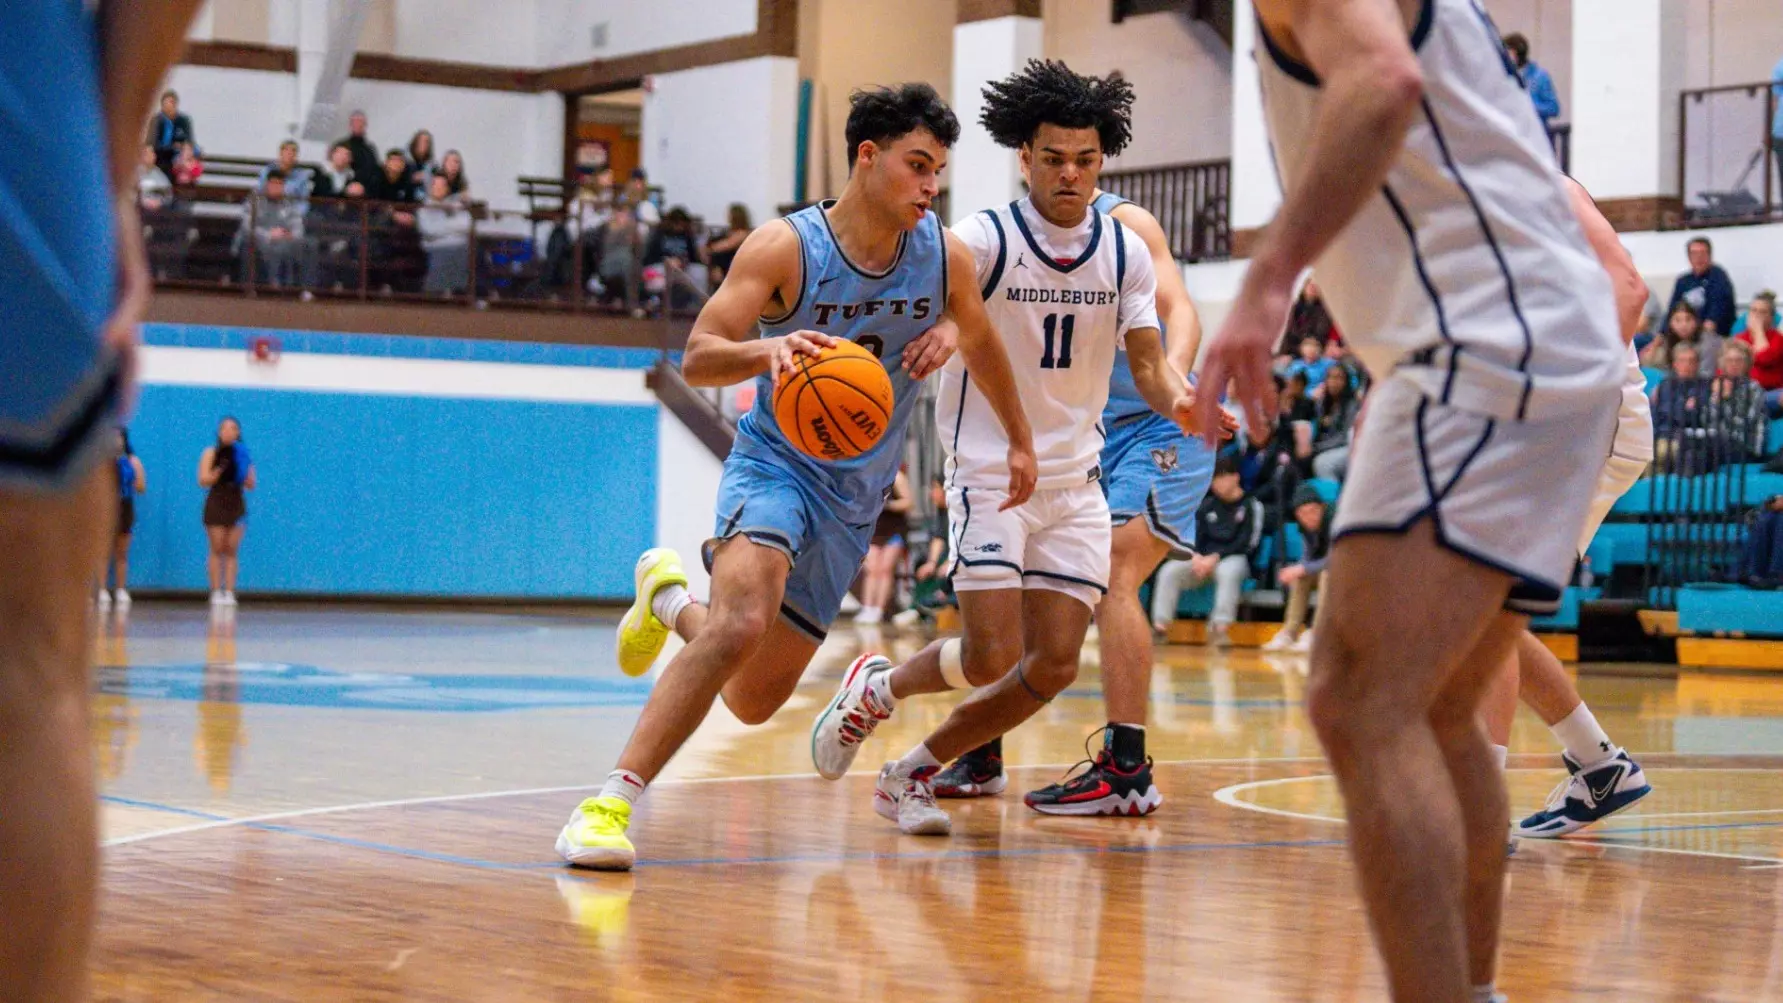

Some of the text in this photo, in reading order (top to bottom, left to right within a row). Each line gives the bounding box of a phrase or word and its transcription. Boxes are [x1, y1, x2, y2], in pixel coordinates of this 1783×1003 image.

[1006, 287, 1117, 306] MIDDLEBURY
[814, 297, 932, 325] TUFTS
[1040, 313, 1075, 369] 11
